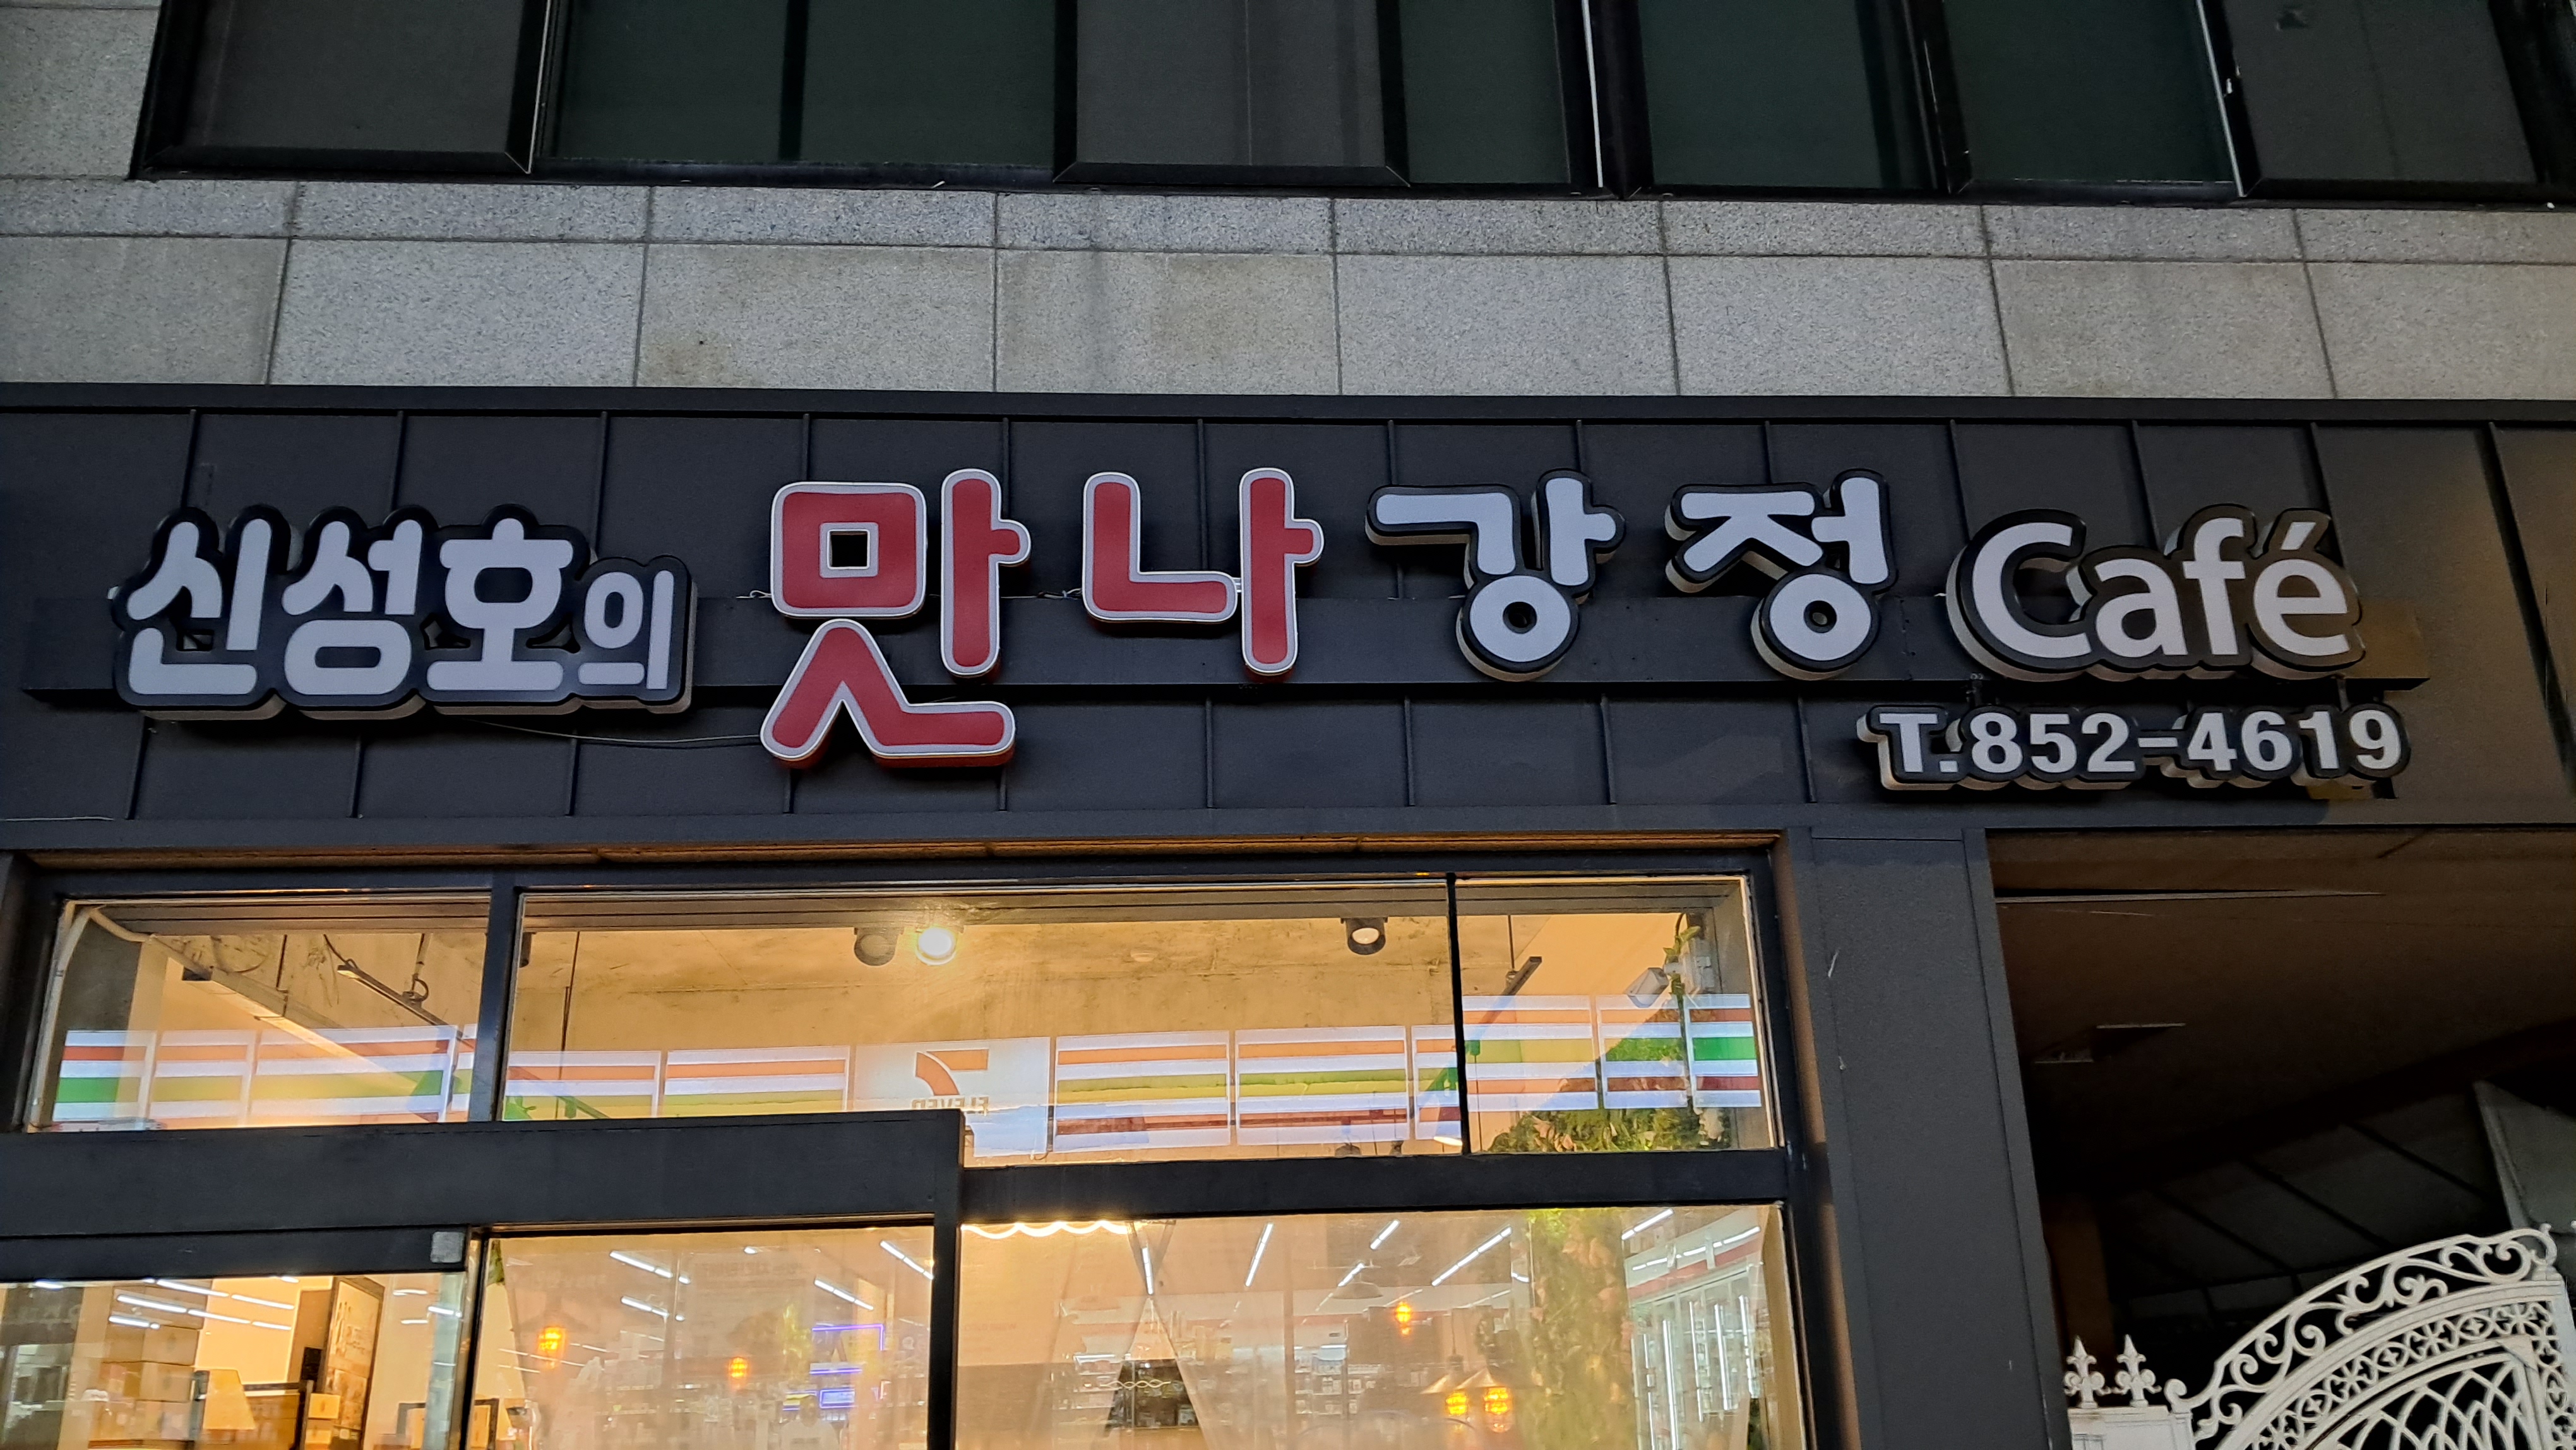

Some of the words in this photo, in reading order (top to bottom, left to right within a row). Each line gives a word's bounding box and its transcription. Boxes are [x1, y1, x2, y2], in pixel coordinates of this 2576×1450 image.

[128, 518, 674, 695] 신성호의
[1972, 518, 2349, 658] Café
[1879, 710, 2400, 773] T.852-4619
